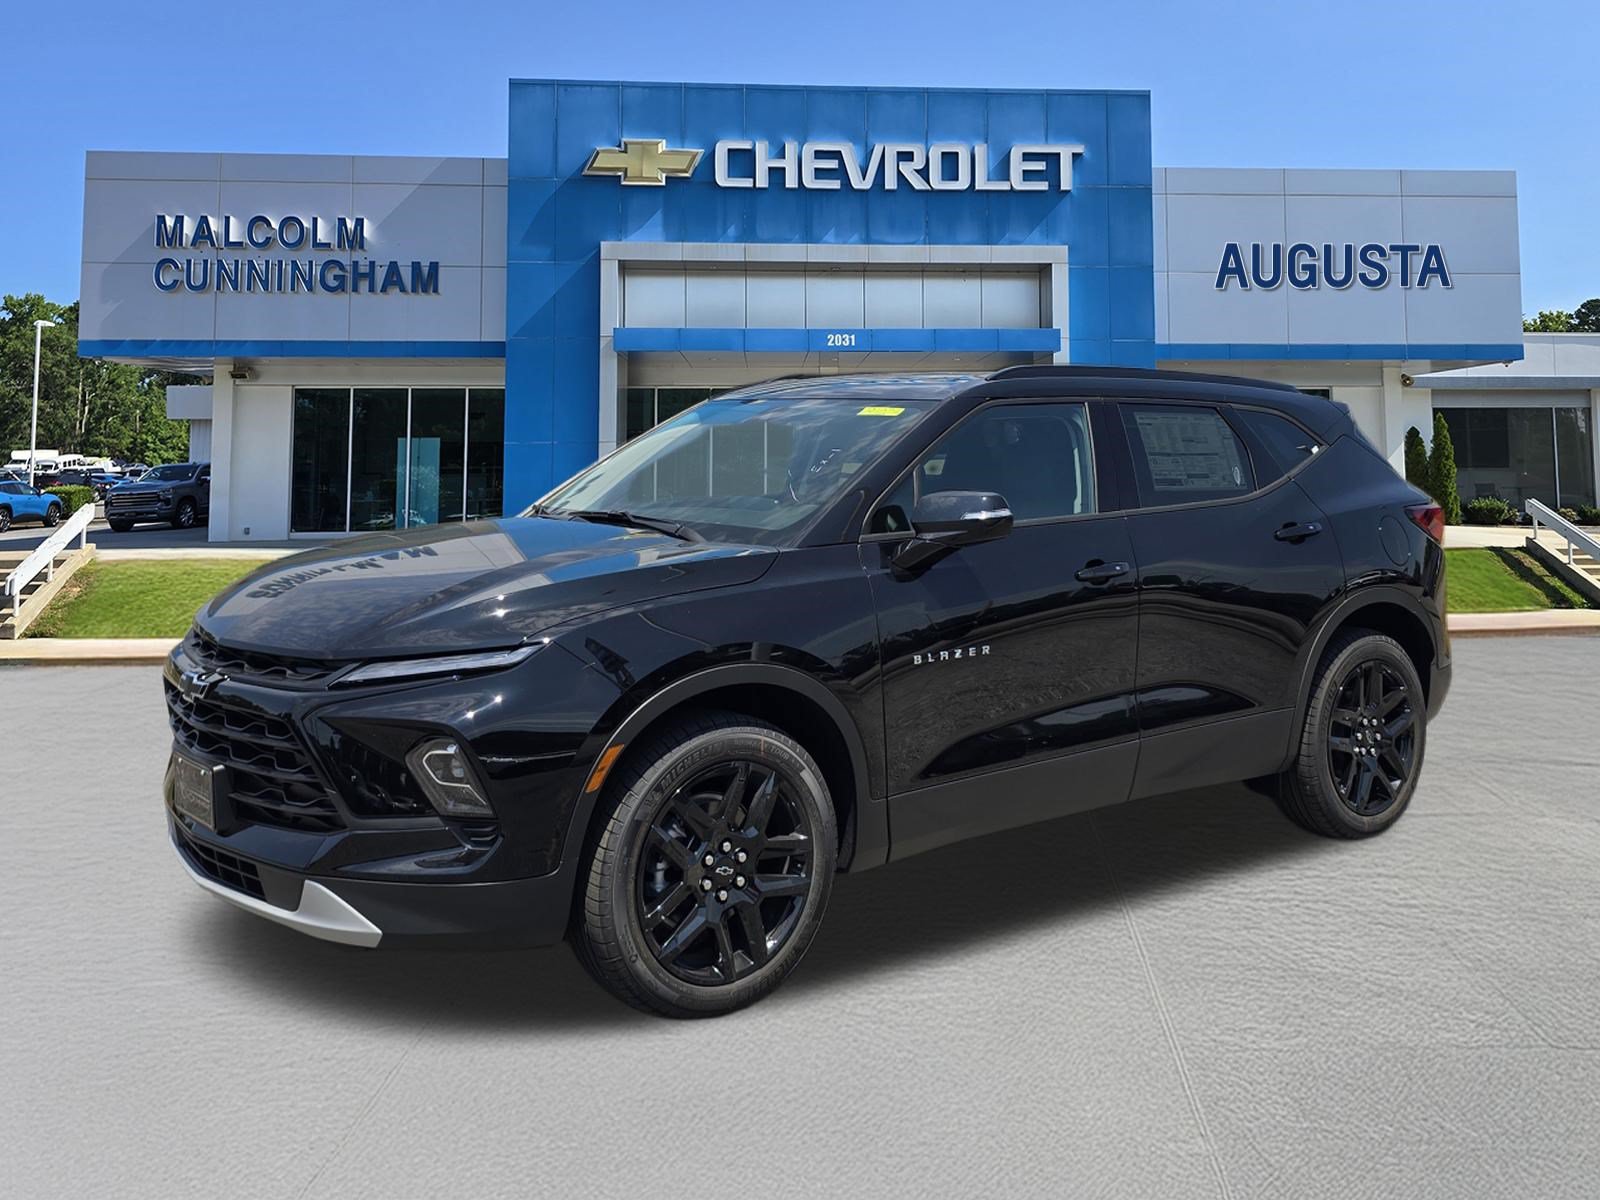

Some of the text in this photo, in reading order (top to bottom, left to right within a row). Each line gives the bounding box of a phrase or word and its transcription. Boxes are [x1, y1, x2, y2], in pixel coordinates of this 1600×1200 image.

[714, 140, 1085, 191] CHEVROLET
[155, 214, 366, 250] MALCOLM
[153, 257, 440, 293] CUNNINGHAM
[1215, 242, 1452, 289] AUGUSTA
[827, 334, 856, 346] 2031
[913, 645, 990, 665] BLAZER
[661, 740, 723, 790] MICHELIN
